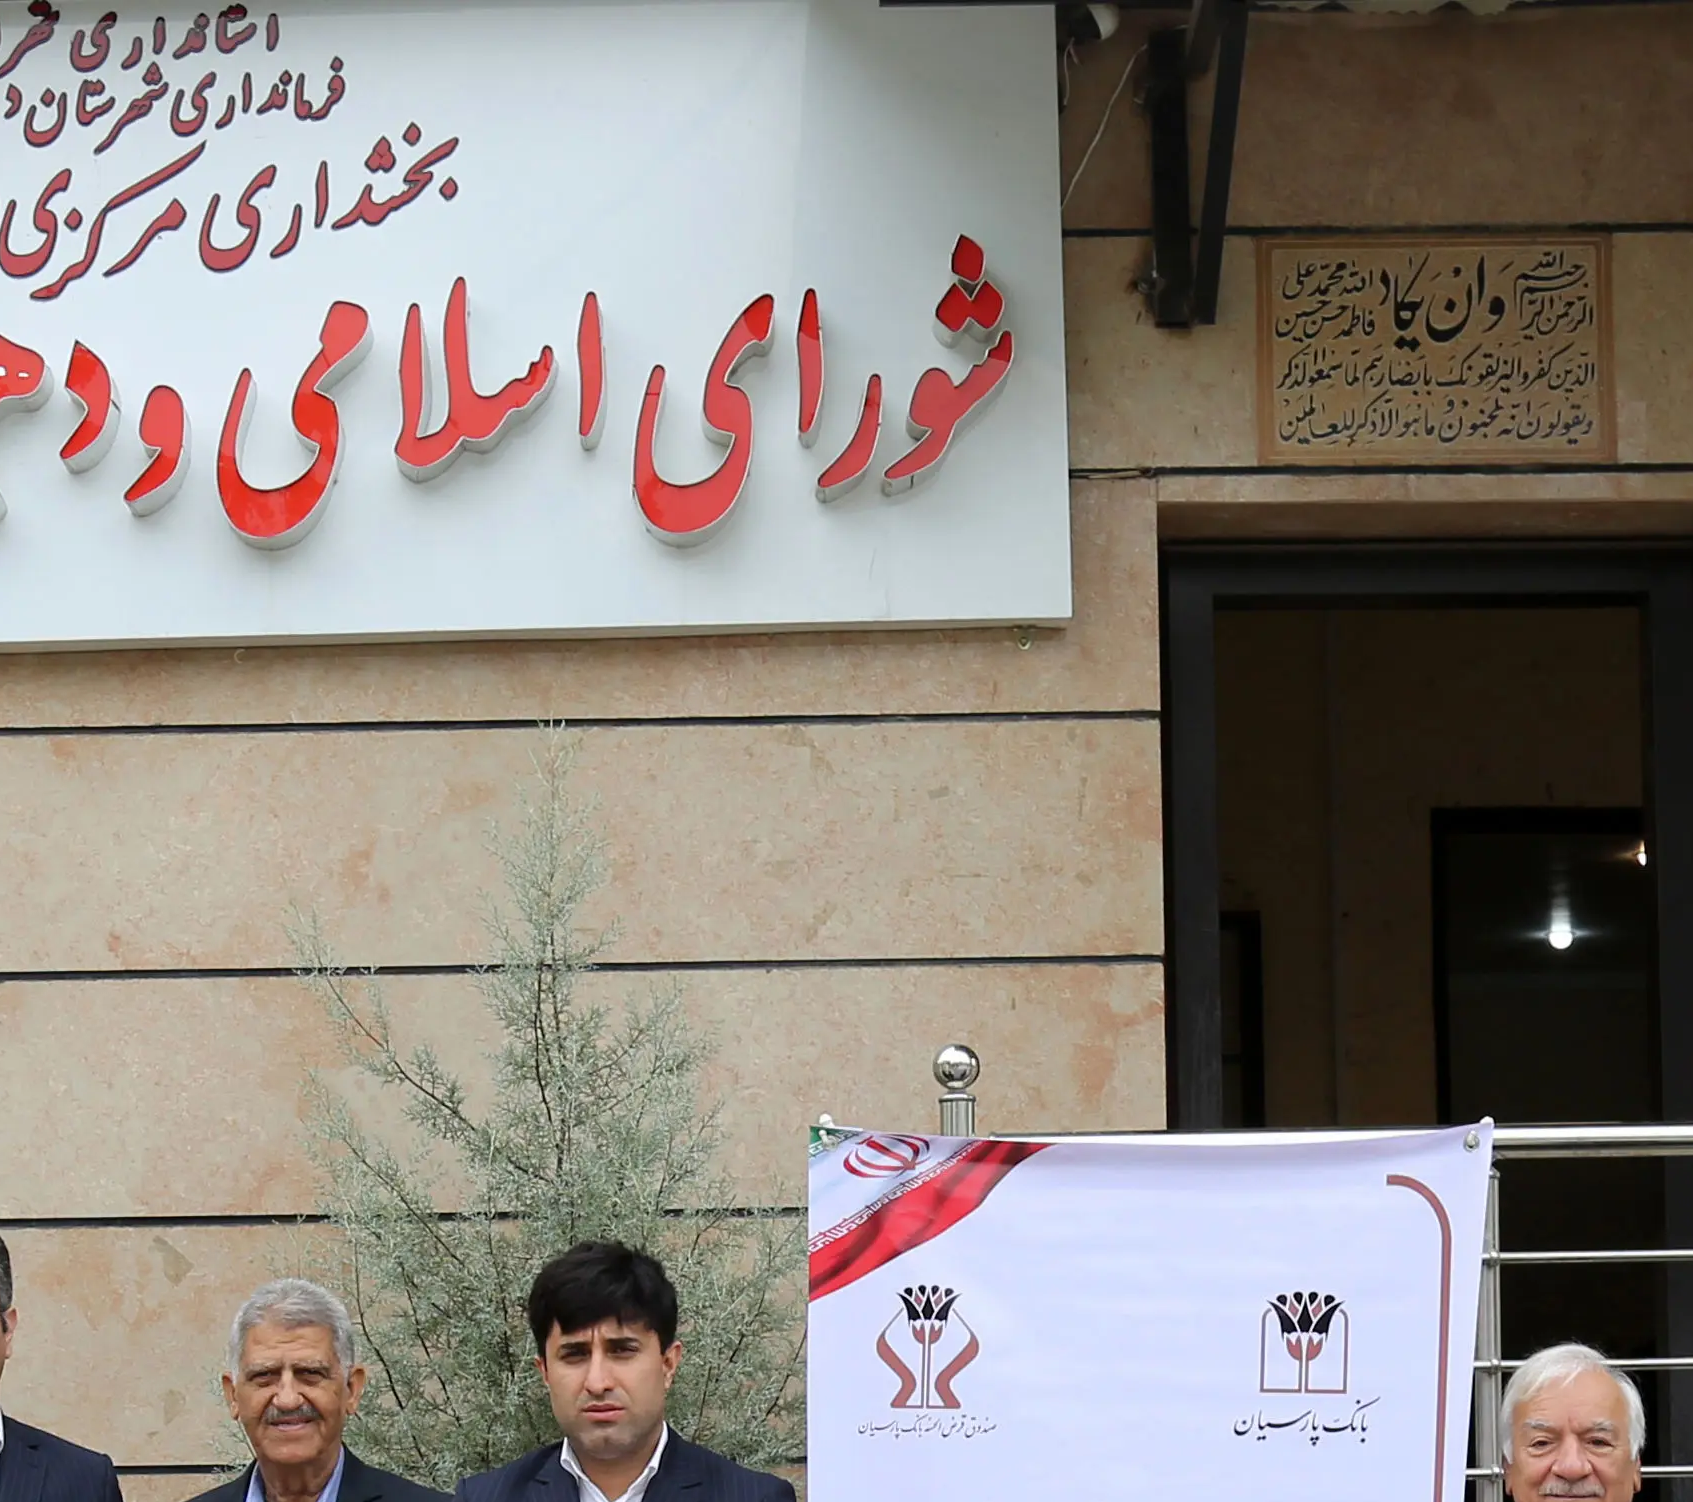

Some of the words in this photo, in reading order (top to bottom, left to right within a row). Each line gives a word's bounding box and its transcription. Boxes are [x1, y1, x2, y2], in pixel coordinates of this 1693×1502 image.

[69, 4, 279, 73] استانداری
[22, 62, 169, 154] شهرستان
[169, 57, 345, 136] فرمانداری
[199, 122, 459, 273] بخشداری
[216, 276, 607, 549] اسلامی
[632, 234, 1017, 545] شورای
[1233, 1409, 1320, 1446] پارسیان
[1322, 1396, 1381, 1443] بانک
